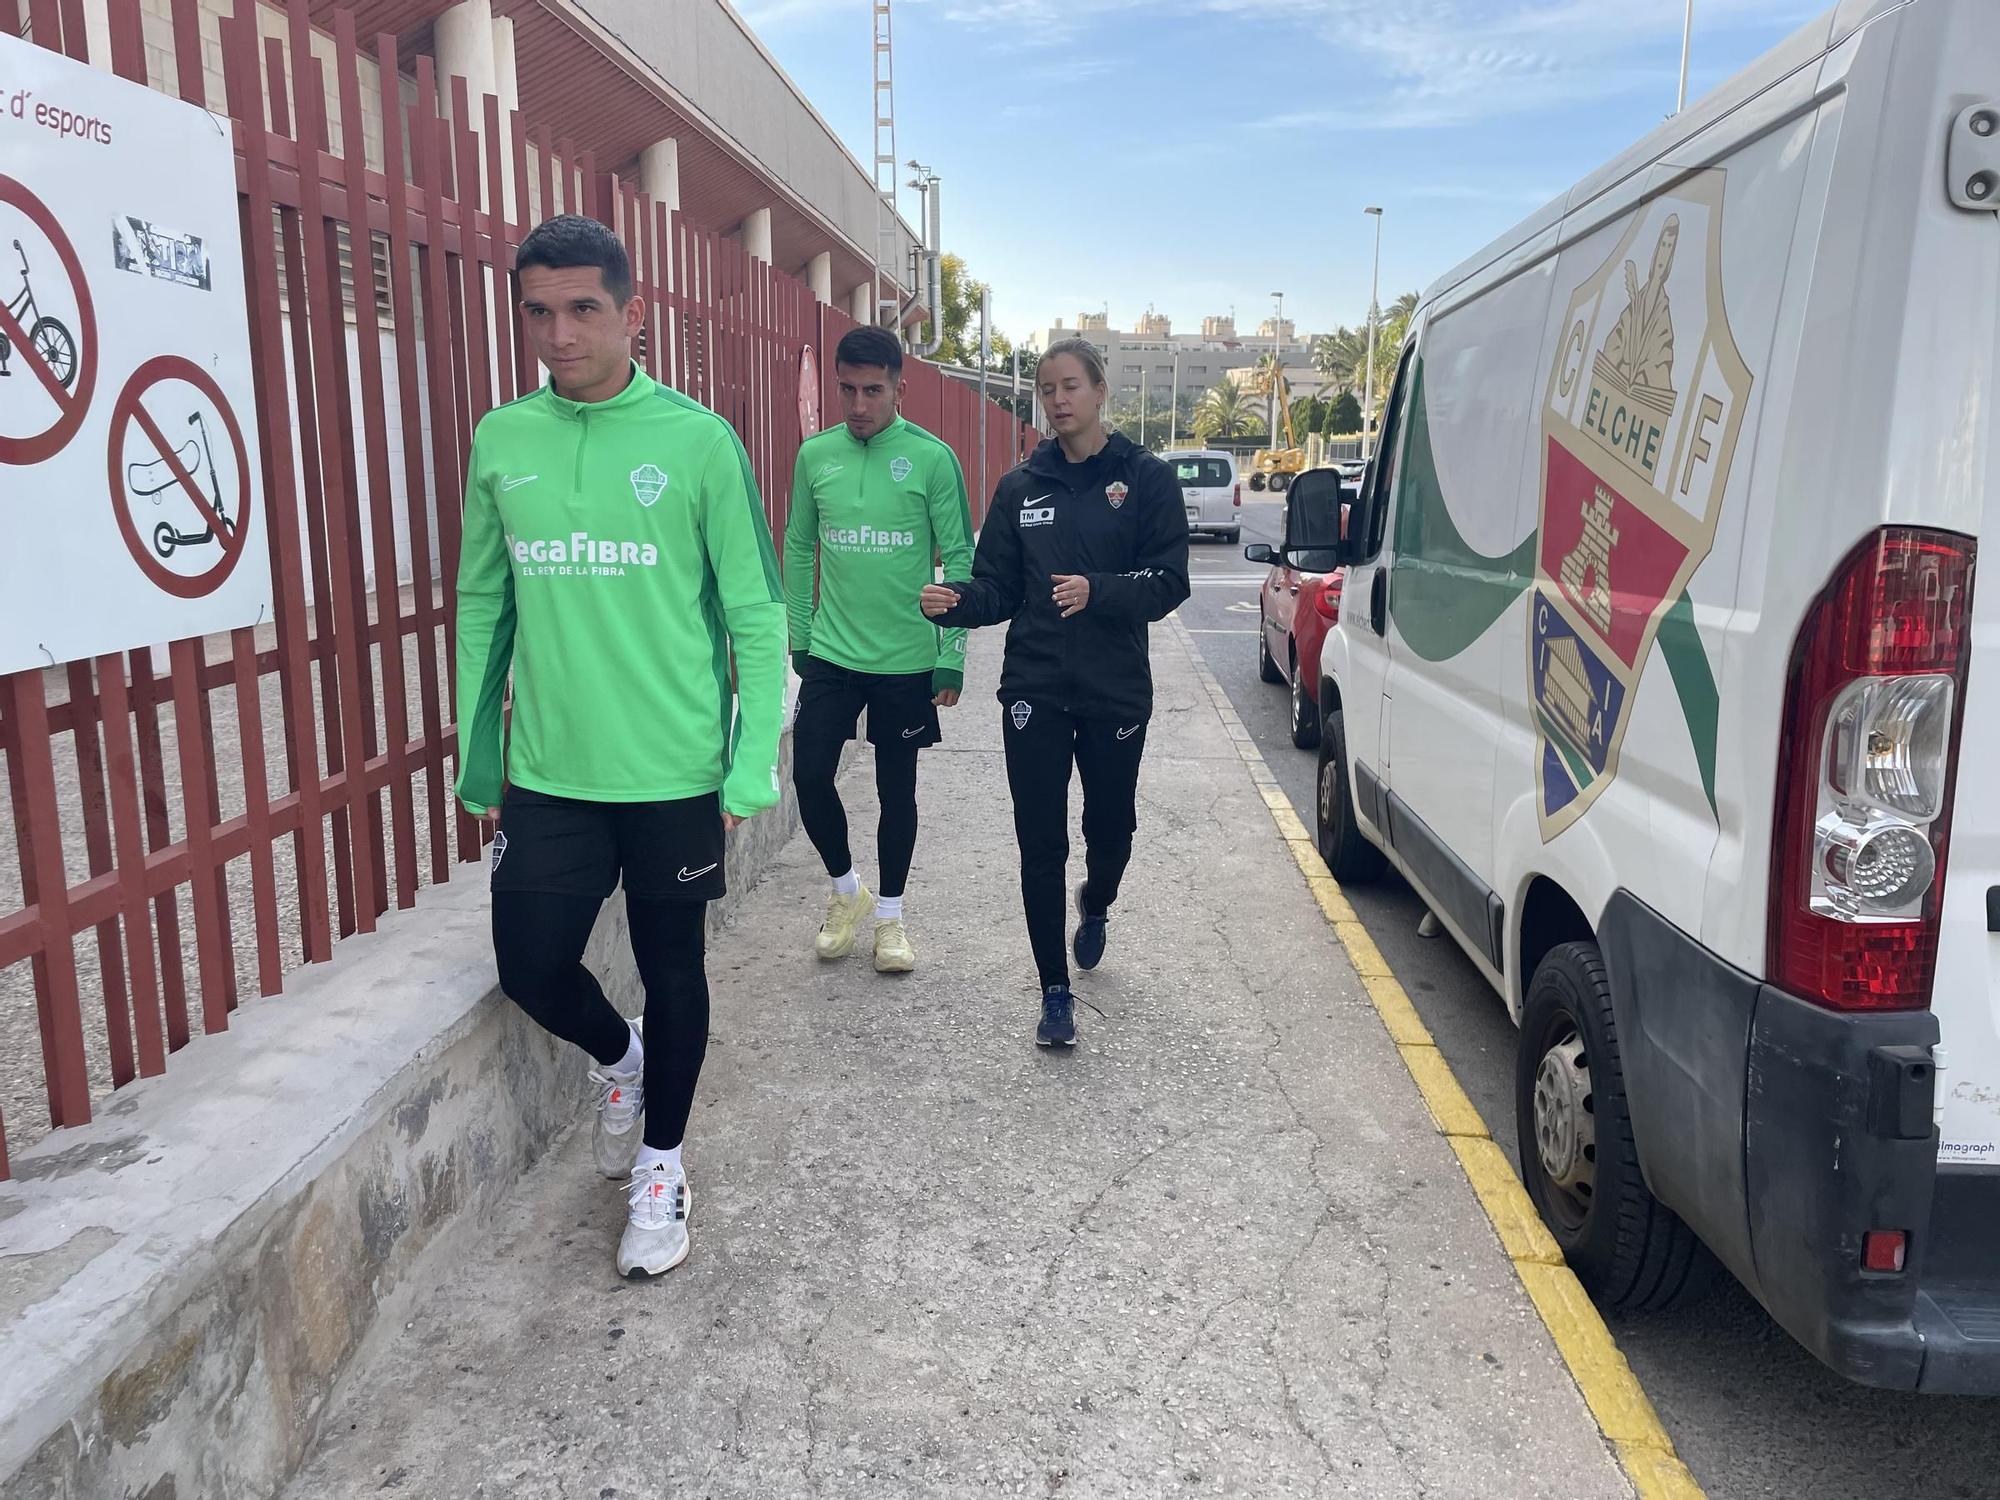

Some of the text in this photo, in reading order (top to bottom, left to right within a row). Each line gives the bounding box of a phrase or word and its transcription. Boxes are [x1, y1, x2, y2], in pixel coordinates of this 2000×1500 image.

[1558, 319, 1585, 398] C
[1584, 387, 1661, 471] ELCHE
[1680, 393, 1724, 496] F
[523, 566, 625, 577] EL REY DE LA FIBRA
